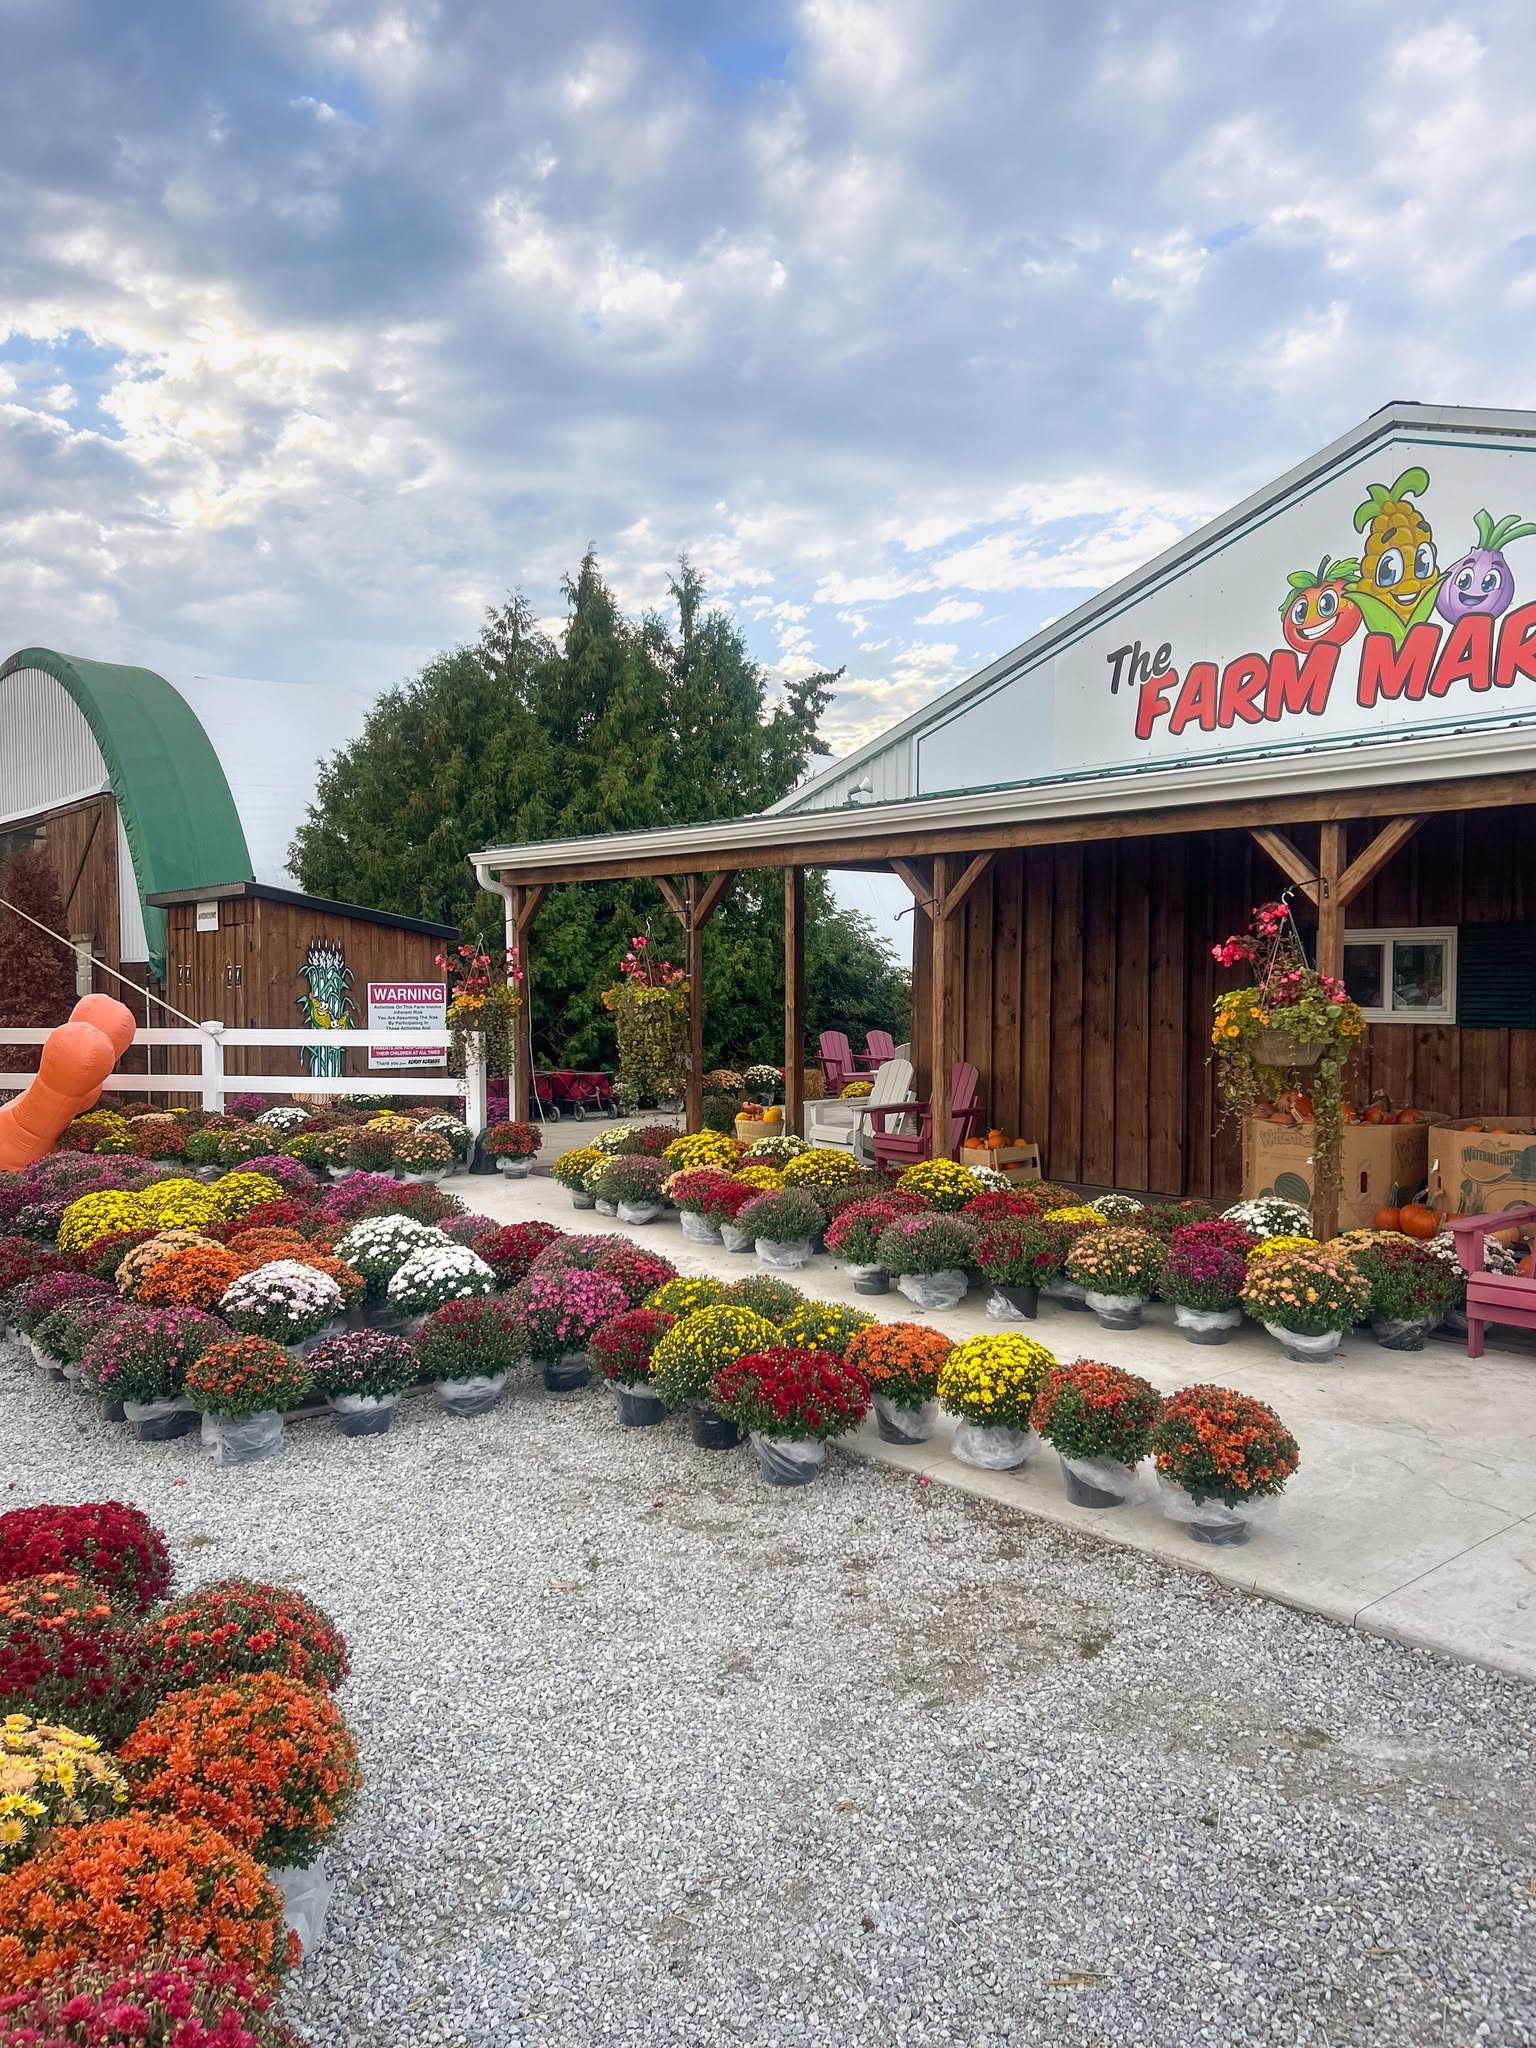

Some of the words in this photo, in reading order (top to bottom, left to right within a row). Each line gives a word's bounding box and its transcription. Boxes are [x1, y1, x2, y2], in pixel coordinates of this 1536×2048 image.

[1107, 640, 1173, 695] The
[1135, 641, 1341, 740] FARM
[373, 988, 443, 1001] WARNING
[1463, 1148, 1514, 1166] WATERMELONS
